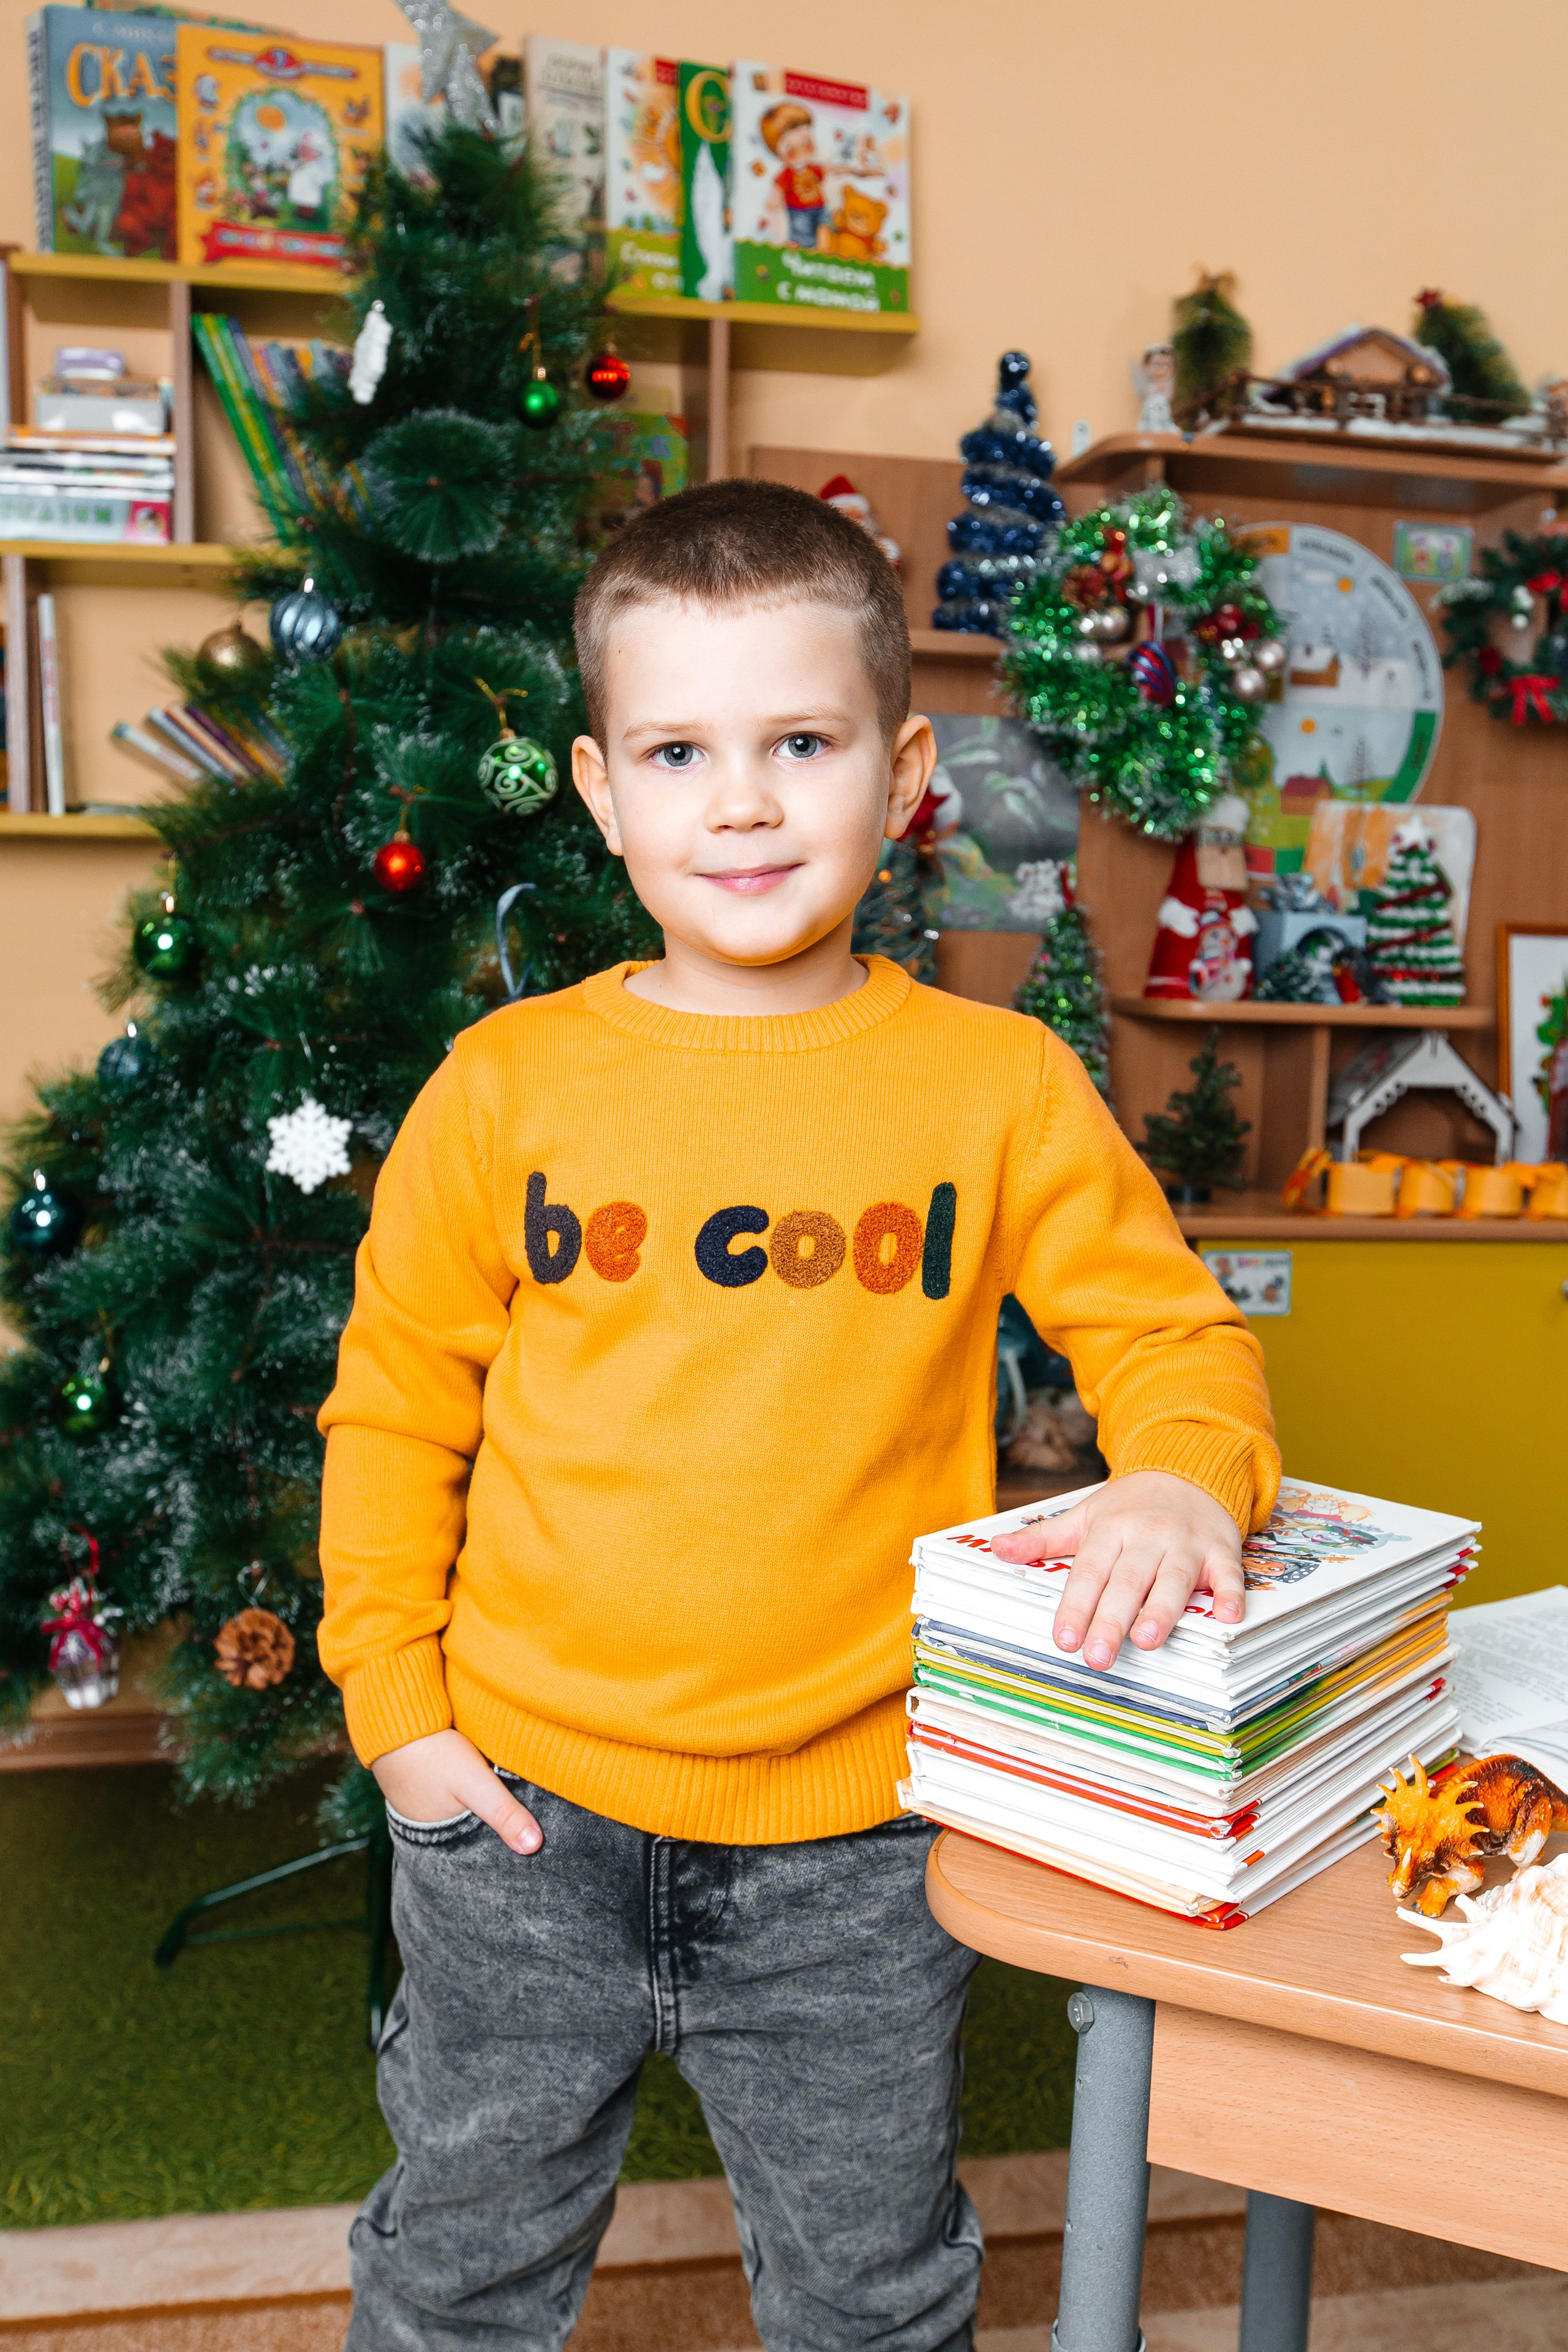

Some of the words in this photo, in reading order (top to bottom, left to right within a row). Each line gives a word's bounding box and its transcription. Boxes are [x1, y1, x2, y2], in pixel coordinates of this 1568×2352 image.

[782, 250, 875, 288] Читаем
[794, 284, 880, 314] мамой
[524, 1171, 647, 1284] be
[695, 1182, 957, 1299] cool
